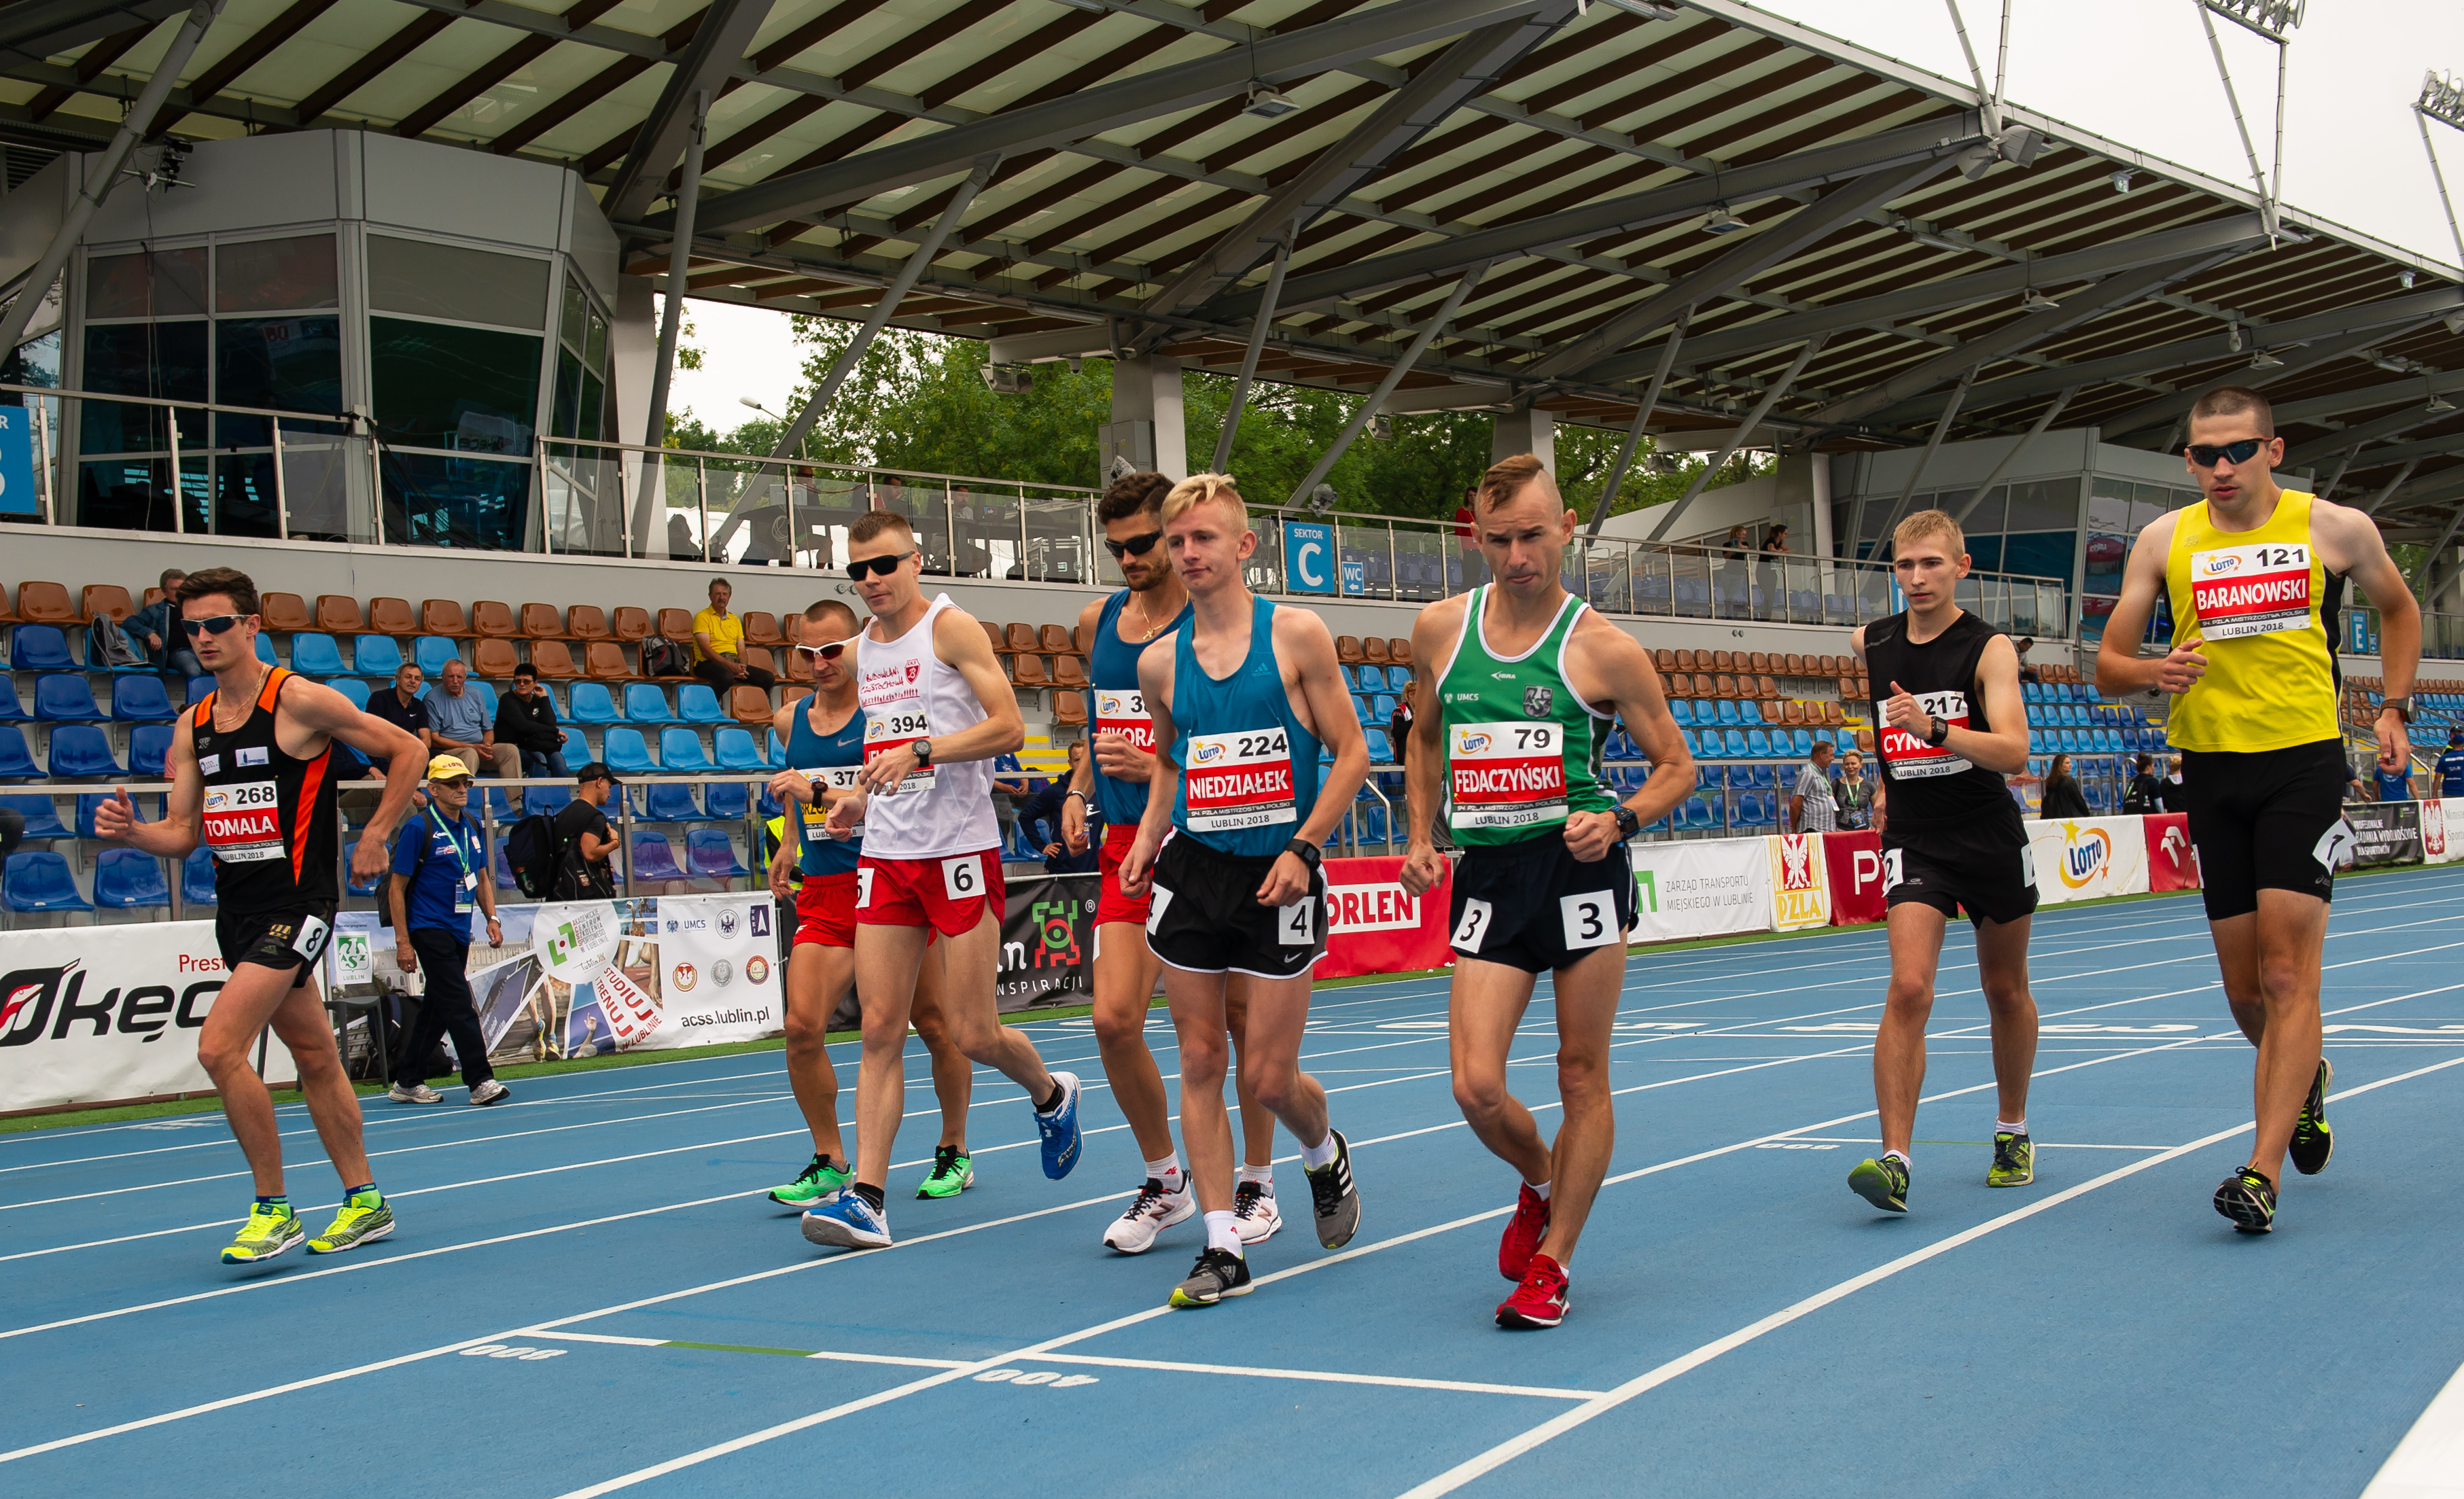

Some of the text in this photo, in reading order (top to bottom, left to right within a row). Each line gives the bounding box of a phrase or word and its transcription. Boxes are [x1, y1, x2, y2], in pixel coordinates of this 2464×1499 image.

[1294, 528, 1323, 540] SEKTOR
[1299, 542, 1323, 586] C
[2211, 548, 2304, 571] LOTTO 121
[1344, 567, 1362, 581] WC
[2196, 578, 2306, 610] BARANOWSKI
[2231, 613, 2281, 622] MISTRZOSTWA
[2222, 622, 2284, 636] LUBLIN 2018
[2355, 624, 2363, 649] E
[1103, 701, 1116, 711] LOTTO
[1457, 693, 1479, 701] UMCS
[1924, 696, 1963, 715] 217
[891, 715, 928, 734] 394
[1199, 734, 1287, 760] LOTTO 224
[1464, 729, 1551, 750] LOTTO 79
[834, 770, 862, 786] 37
[1454, 762, 1560, 793] FEDACZYŃSKI
[1929, 766, 1951, 775] 2018
[900, 782, 916, 790] 2018
[1190, 769, 1288, 799] NIEDZIAŁEK
[207, 786, 275, 806] LOTTO 268
[1218, 805, 1265, 815] MISTRZOSTWA
[1485, 802, 1534, 811] MISTRZOSTWA
[205, 816, 276, 836] TOMALA
[1211, 815, 1269, 828] LUBLIN 2018
[1475, 813, 1538, 825] LUBLIN 2018
[2069, 839, 2101, 875] LOTTO
[953, 864, 973, 892] 6
[1666, 875, 1749, 894] ZARZĄD TRANSPORTU
[1327, 889, 1413, 927] ORLEN
[1667, 892, 1754, 912] MIEJSKIEGO W LUBLINIE
[1778, 892, 1822, 921] PZLA
[572, 909, 599, 926] AKADEMICKIE
[574, 915, 601, 933] CENTRUM
[684, 919, 706, 929] UMCS
[1290, 904, 1307, 937] 4
[1460, 909, 1482, 942] 3
[1578, 902, 1603, 940] 3
[305, 928, 323, 953] 8
[576, 923, 603, 940] SZKOLENIA
[578, 928, 606, 947] SPORTOWEGO
[587, 936, 610, 951] LUBLINIE
[603, 967, 654, 1021] STUDIUJ
[997, 976, 1083, 996] NSPIRACJI
[596, 978, 634, 1038] TRENUJ
[682, 1006, 770, 1027] acss.lublin.pl
[631, 1015, 663, 1046] LUBLINIE
